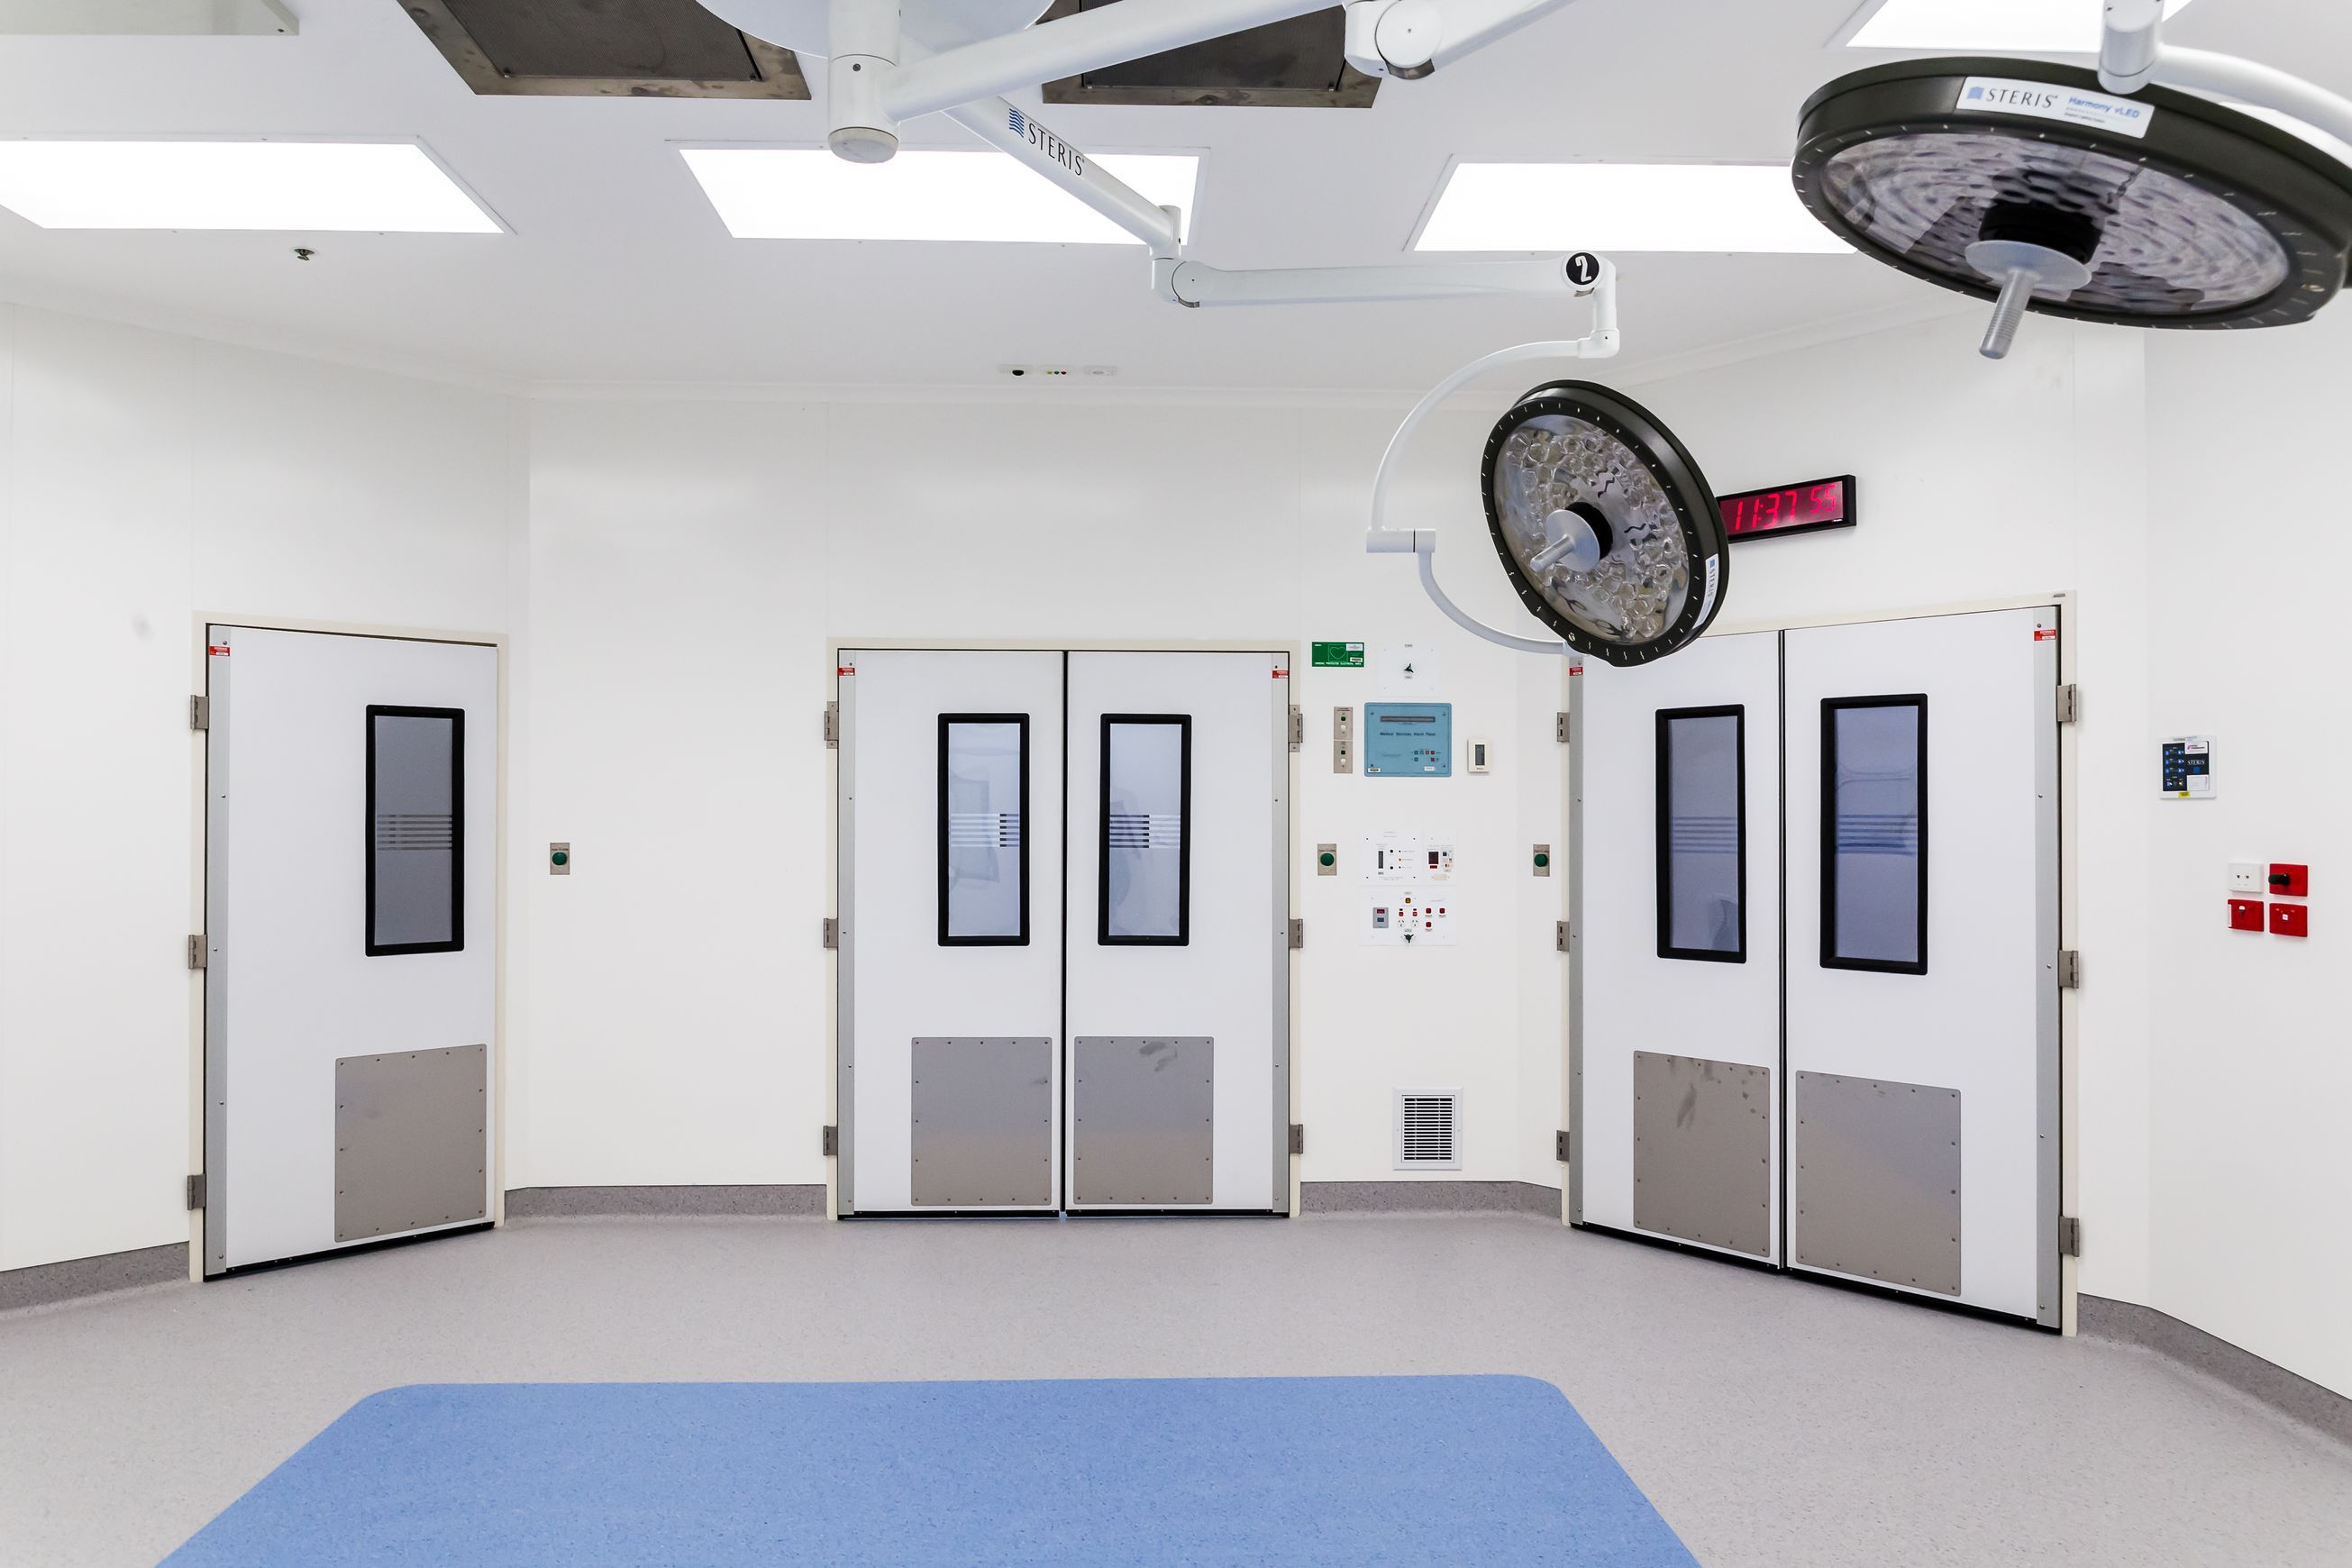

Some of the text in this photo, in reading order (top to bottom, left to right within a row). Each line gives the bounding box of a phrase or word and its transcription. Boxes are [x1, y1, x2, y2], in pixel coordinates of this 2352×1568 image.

[1986, 87, 2055, 109] STERIS
[2068, 96, 2112, 113] Harmony
[1028, 123, 1083, 176] STERIS
[1574, 255, 1592, 282] 2
[1735, 484, 1837, 531] 11:37 55
